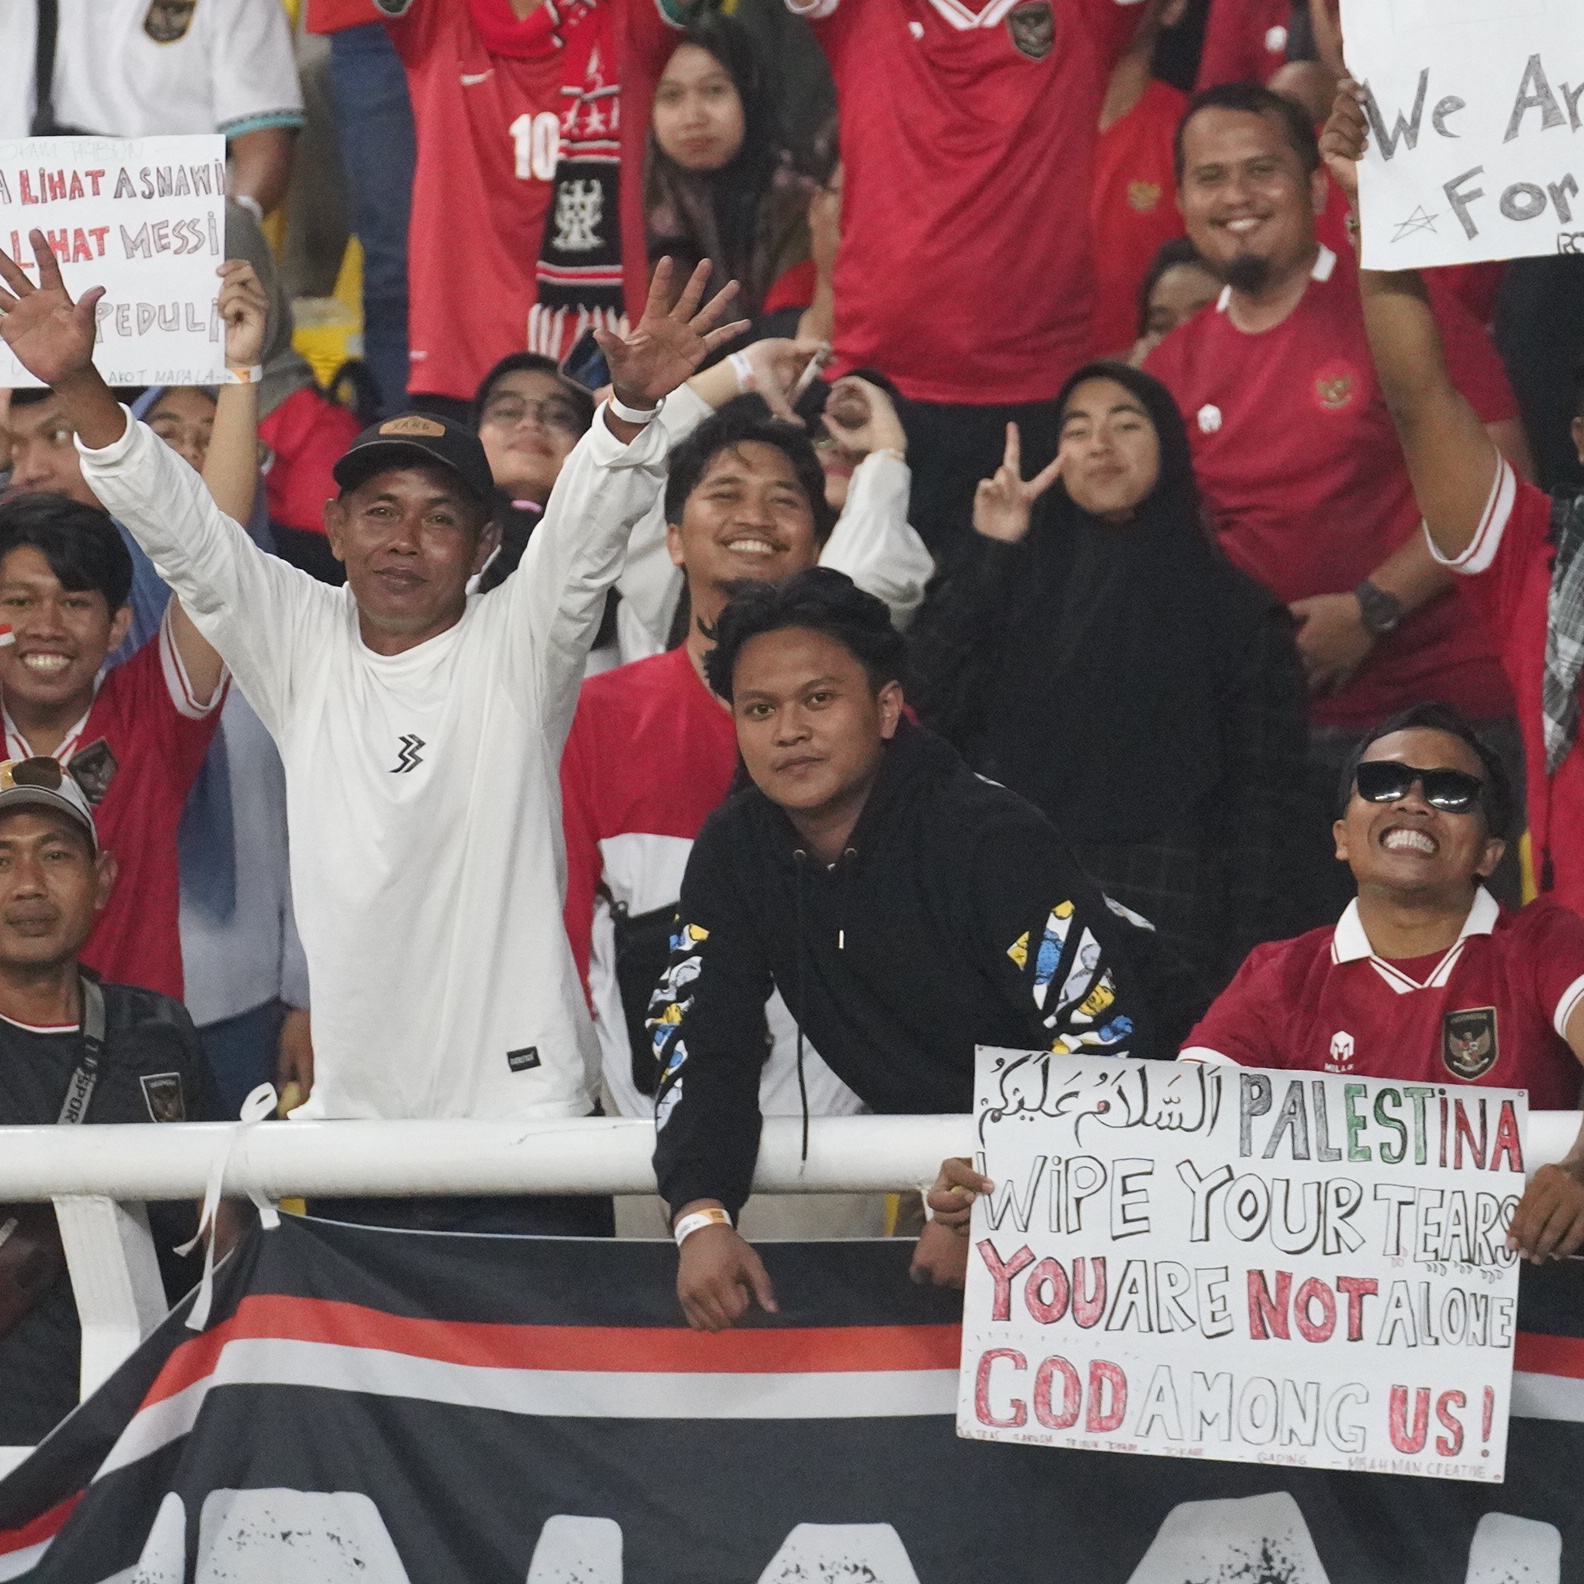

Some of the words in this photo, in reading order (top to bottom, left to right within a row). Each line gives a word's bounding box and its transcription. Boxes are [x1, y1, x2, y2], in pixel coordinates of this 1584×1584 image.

[509, 111, 561, 182] 10
[1358, 66, 1467, 162] We
[9, 224, 111, 270] LHAT
[1175, 1158, 1366, 1256] YOUR
[975, 1237, 1108, 1330] YOU
[1104, 1259, 1234, 1339] ARE
[1245, 1268, 1379, 1344] NOT
[1376, 1278, 1516, 1350] ALONE
[973, 1346, 1129, 1434] GOD
[1134, 1364, 1370, 1454] AMONG
